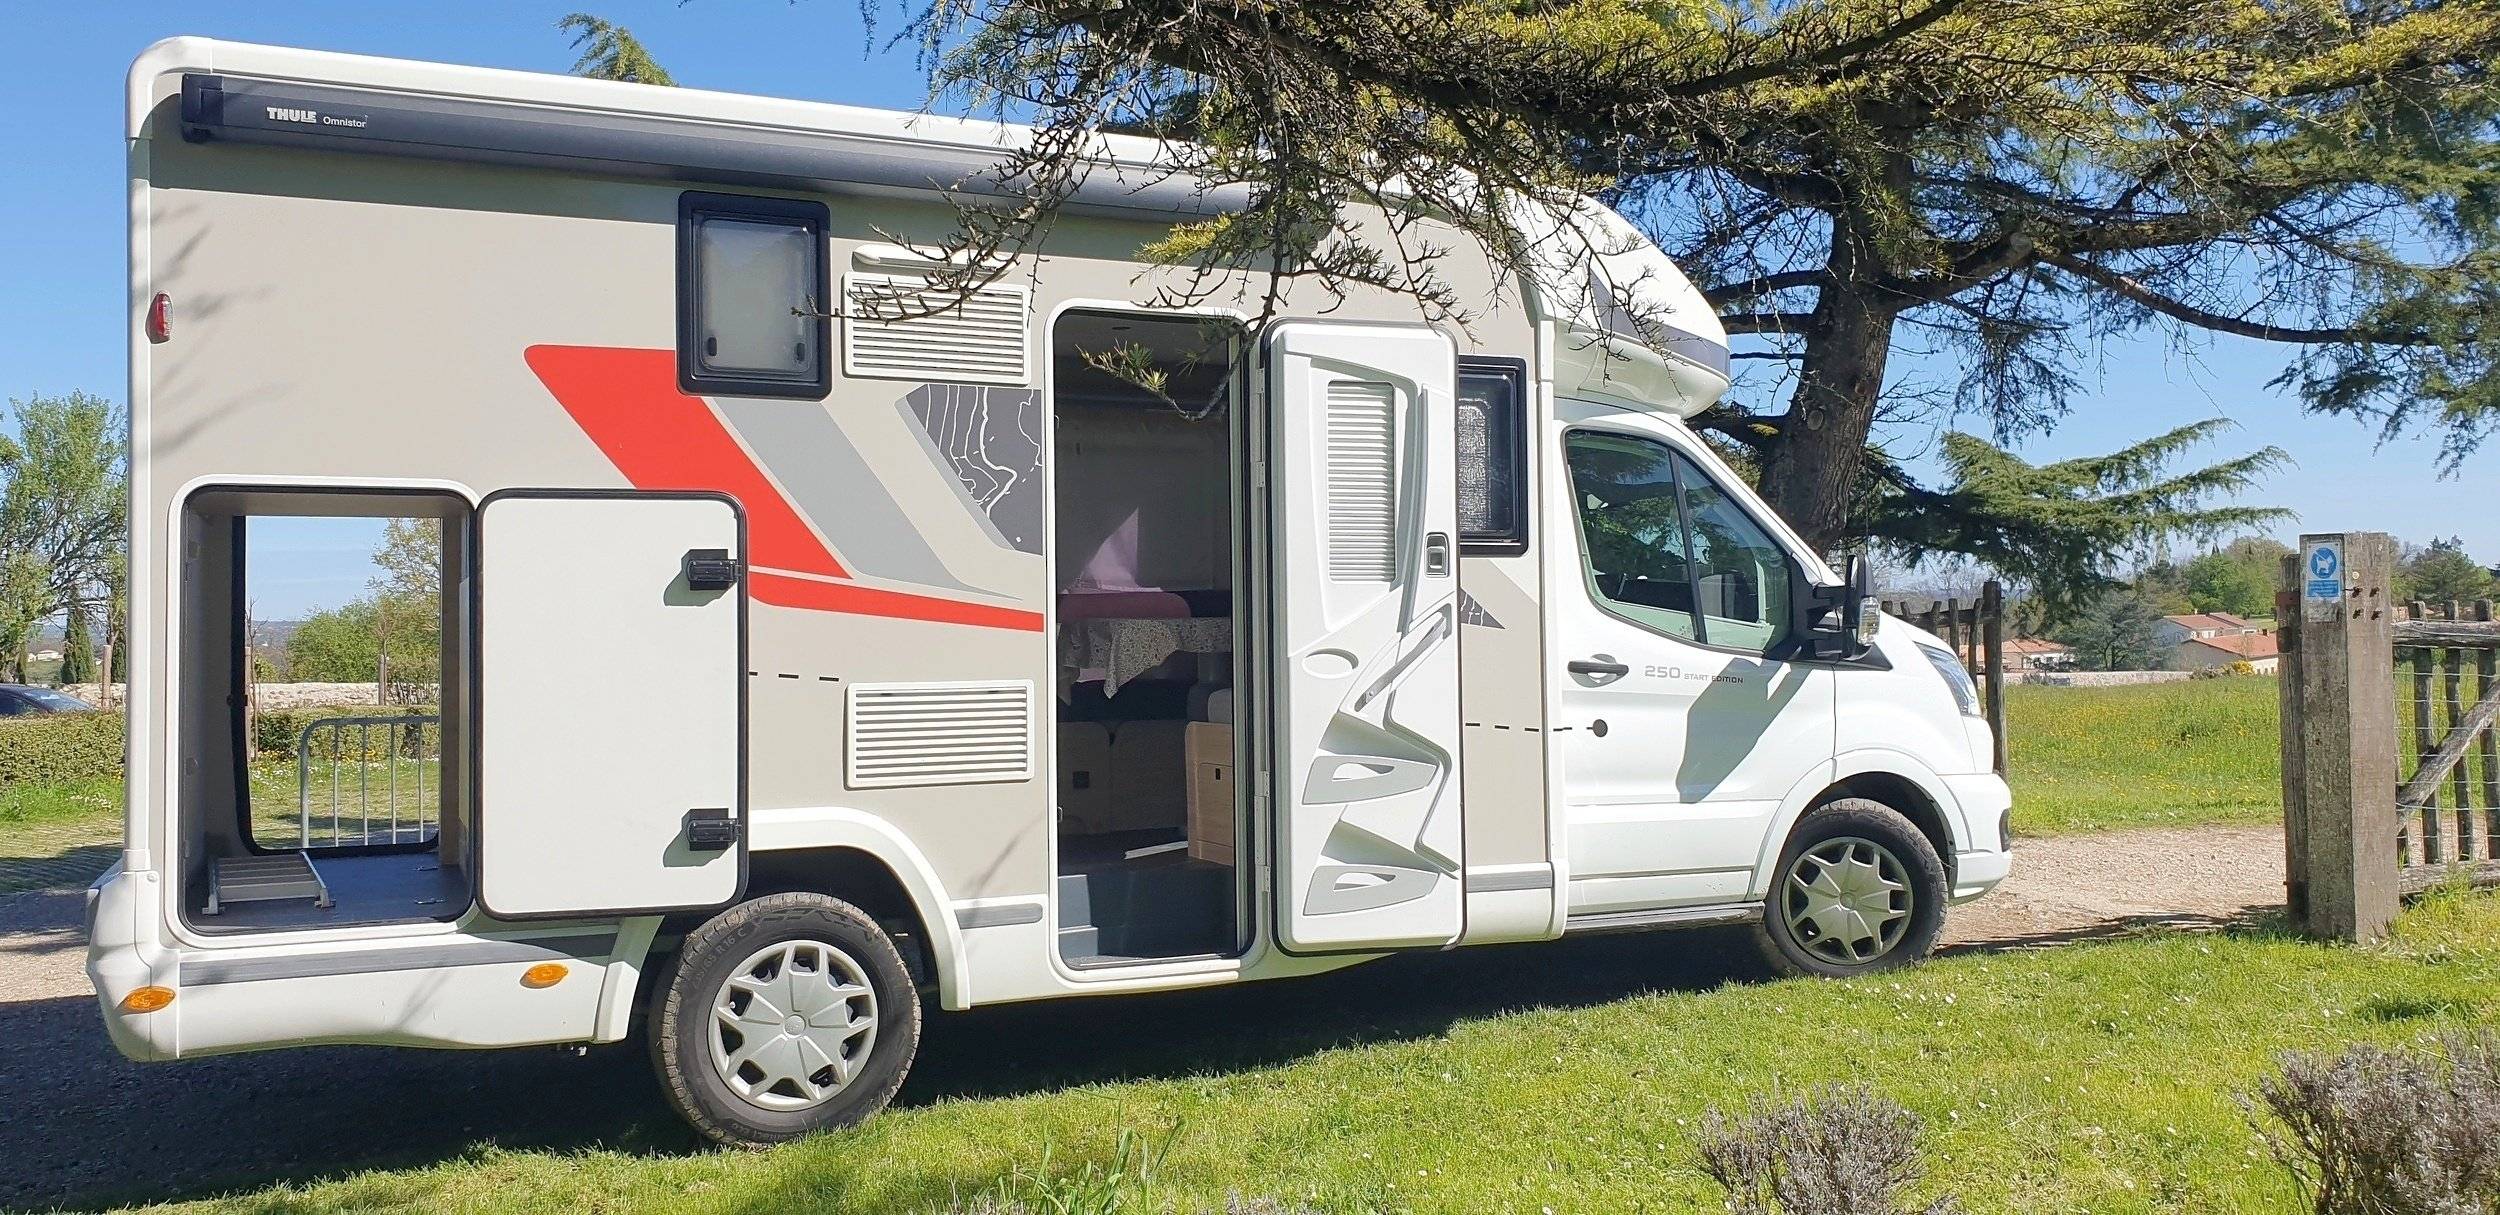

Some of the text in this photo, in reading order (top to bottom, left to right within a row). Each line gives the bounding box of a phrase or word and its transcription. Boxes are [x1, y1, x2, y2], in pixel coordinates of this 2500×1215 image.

[266, 107, 366, 127] THULE Omnistor
[1645, 665, 1743, 683] 250 START EDITION
